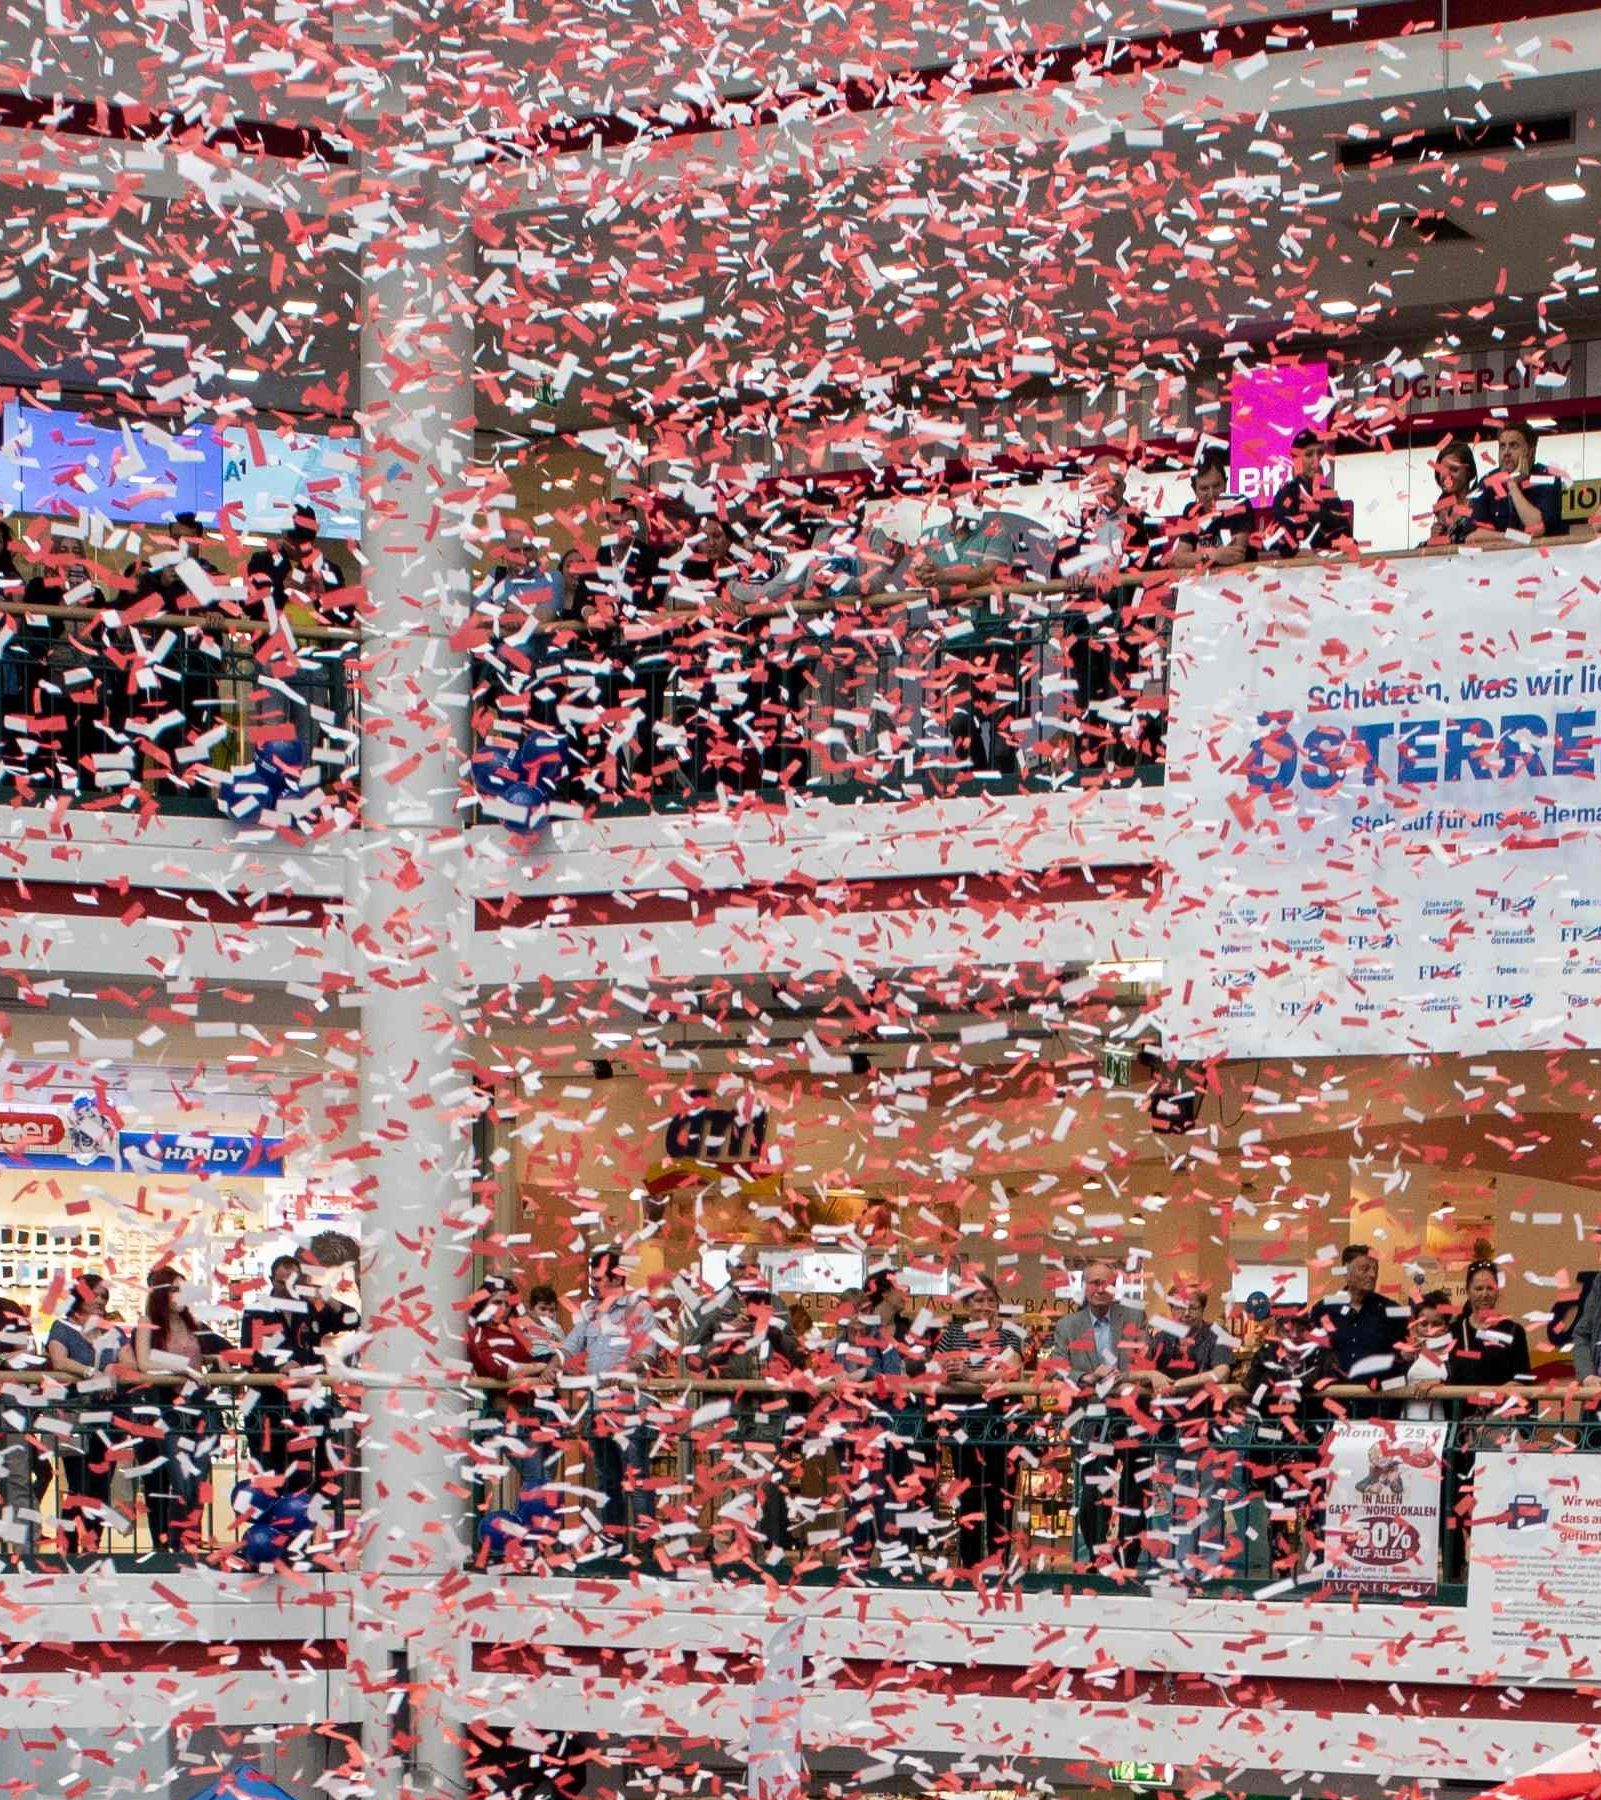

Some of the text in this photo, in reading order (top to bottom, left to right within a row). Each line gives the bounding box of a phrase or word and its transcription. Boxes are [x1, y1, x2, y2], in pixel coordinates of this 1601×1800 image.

[1526, 668, 1574, 697] wir
[163, 1145, 244, 1163] HANDY
[1338, 1426, 1396, 1440] Monta
[1362, 1494, 1403, 1504] IN ALLEN
[1562, 1495, 1583, 1506] Wir
[1328, 1505, 1437, 1516] GASTNOMIELOKALEN
[1560, 1513, 1590, 1524] dass
[1559, 1531, 1601, 1546] gefilmt
[1353, 1549, 1403, 1559] AUF ALLES
